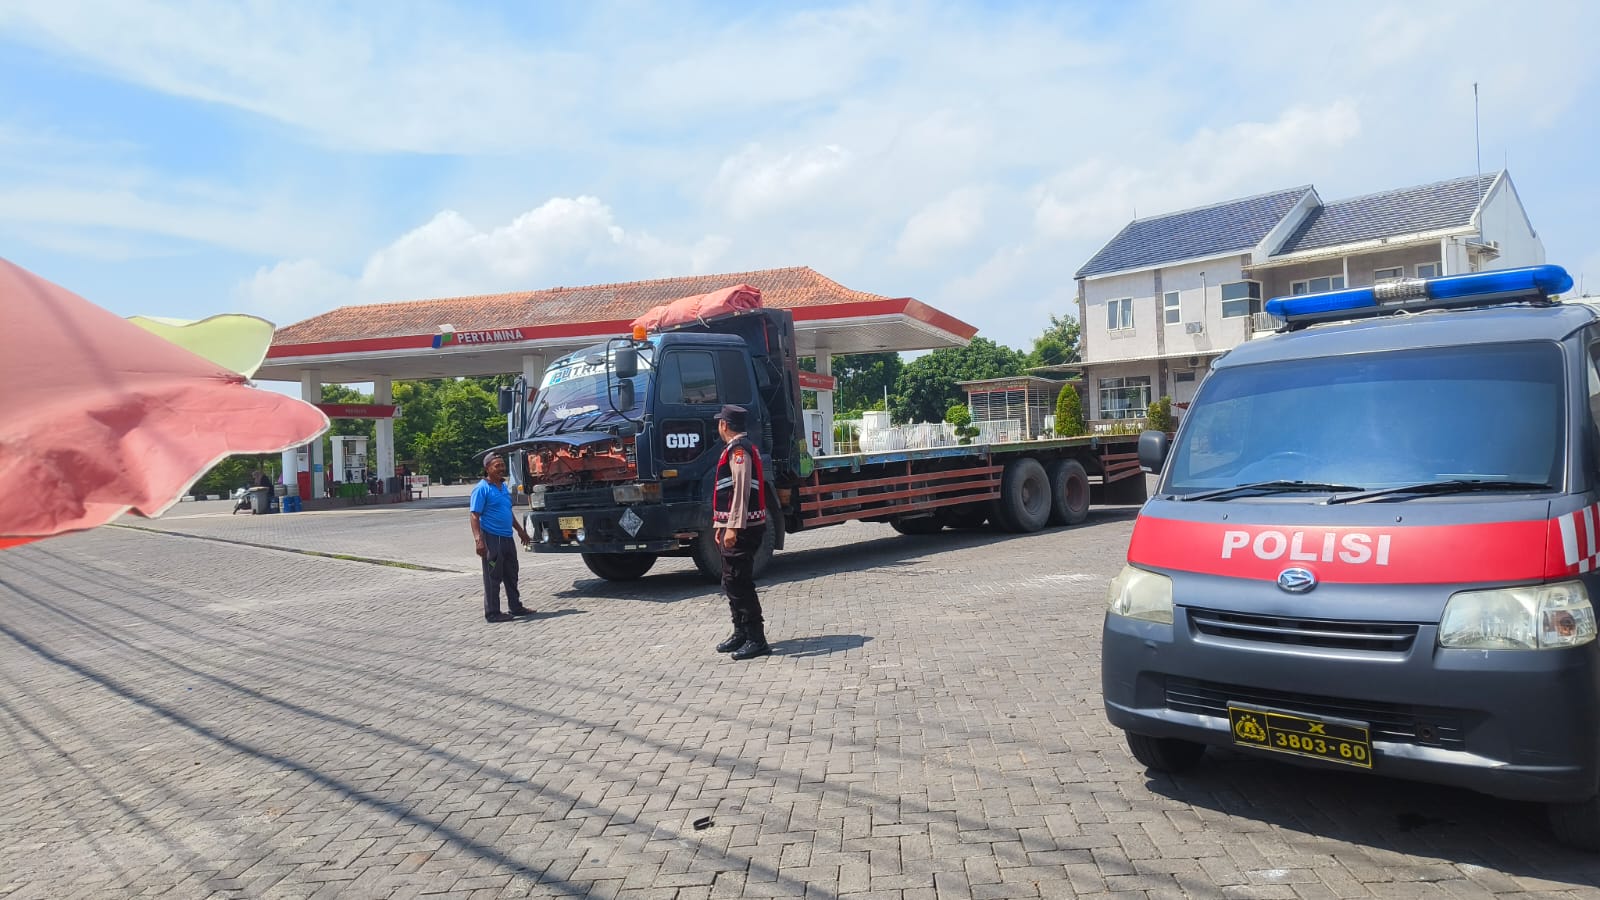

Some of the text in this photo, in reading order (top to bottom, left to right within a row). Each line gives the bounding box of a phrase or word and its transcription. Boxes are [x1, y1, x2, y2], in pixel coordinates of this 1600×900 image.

[457, 329, 523, 344] PERTAMINA
[666, 433, 700, 449] GDP
[1221, 530, 1392, 566] POLISI
[1308, 721, 1326, 735] X
[1275, 731, 1366, 761] 3803-60
